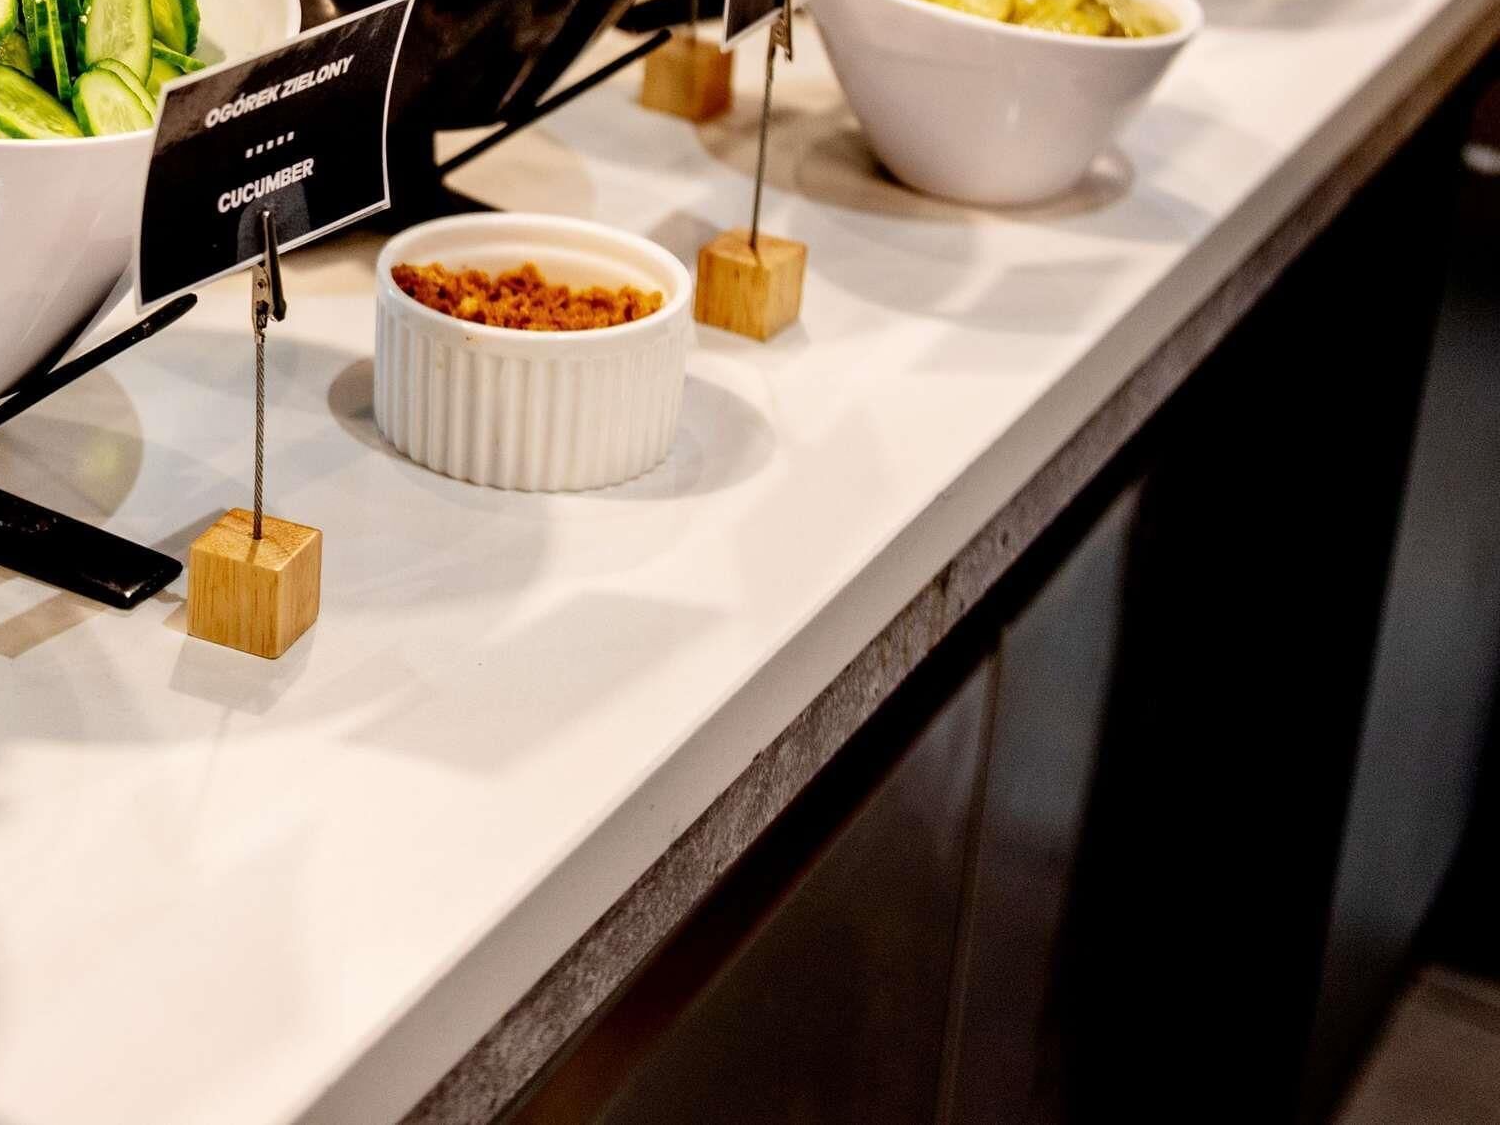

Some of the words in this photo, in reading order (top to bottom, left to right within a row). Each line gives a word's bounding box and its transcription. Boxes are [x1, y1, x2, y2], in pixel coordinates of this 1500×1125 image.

[204, 83, 281, 128] OGÓREK
[280, 54, 355, 99] ZIELONY
[217, 158, 314, 213] CUCUMBER
